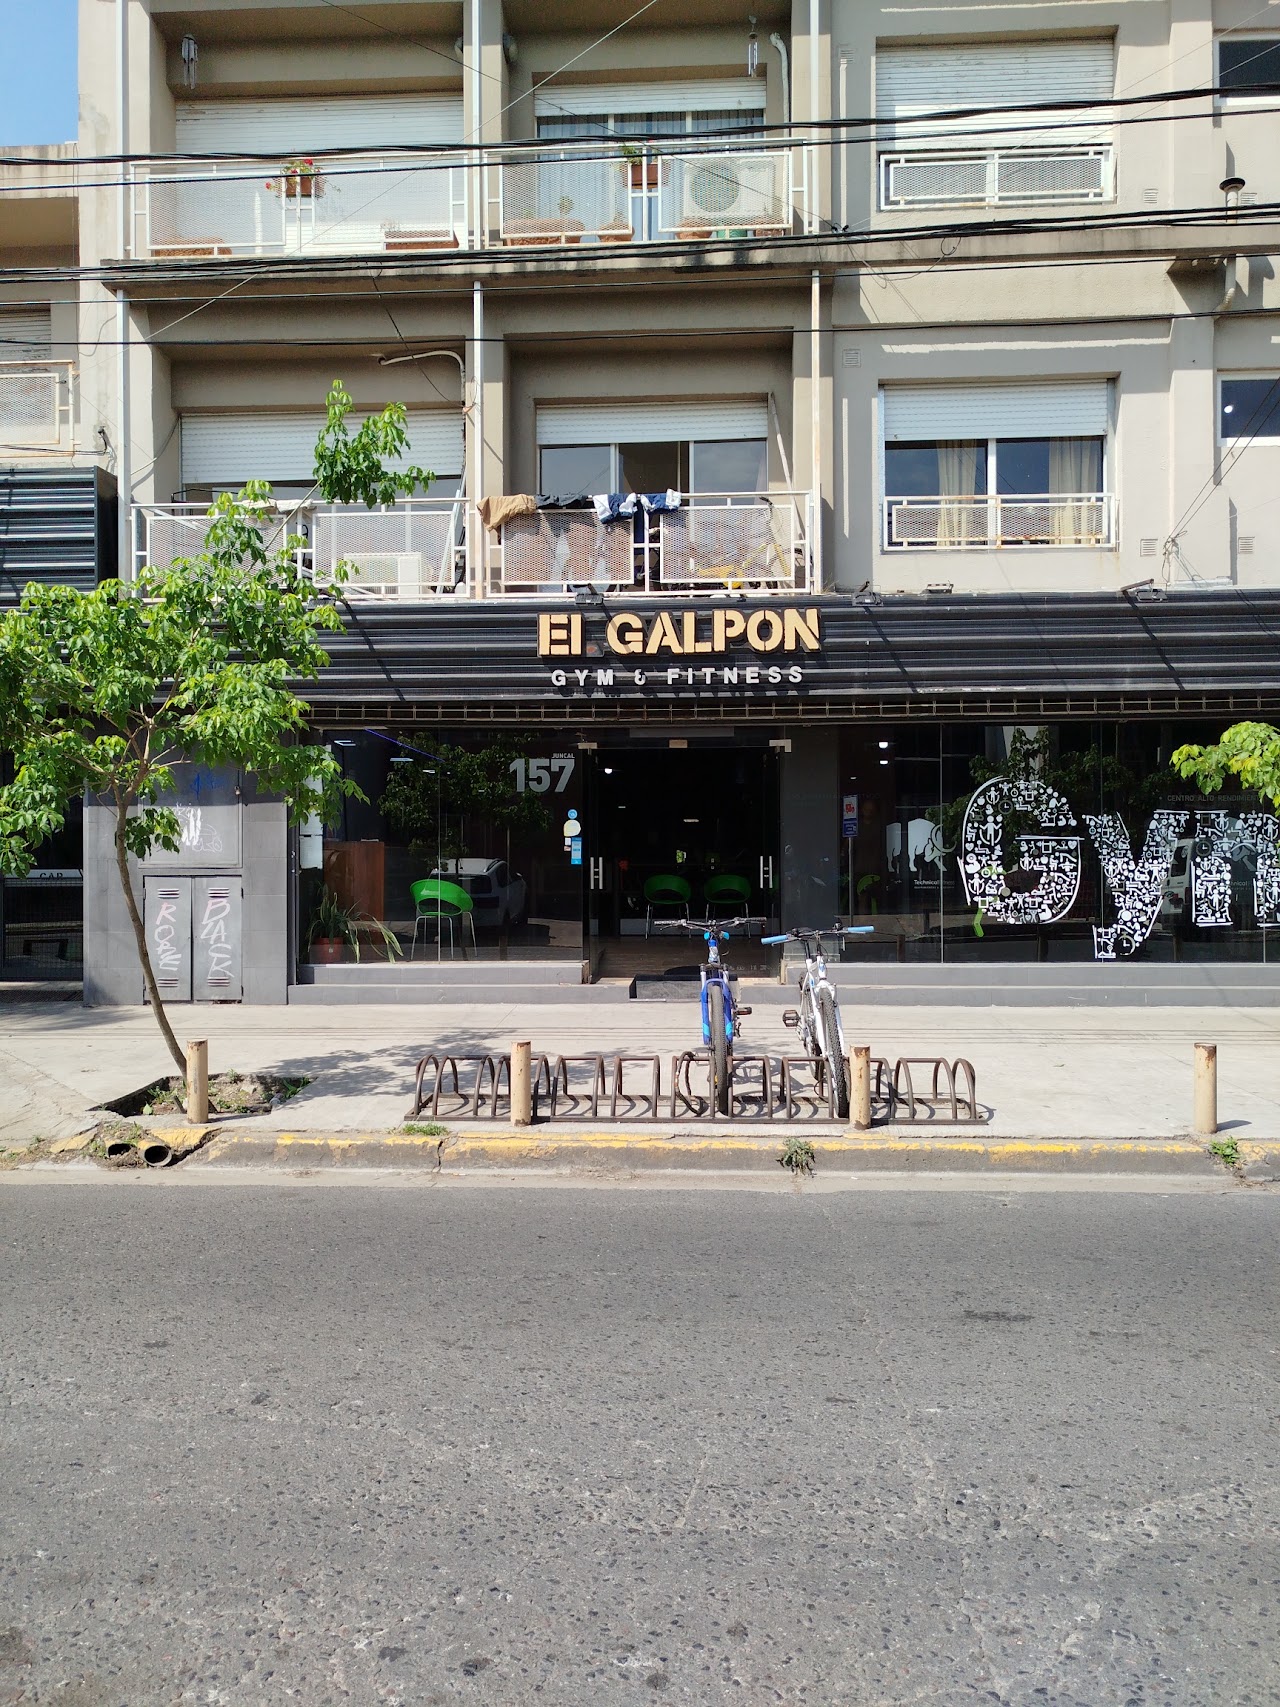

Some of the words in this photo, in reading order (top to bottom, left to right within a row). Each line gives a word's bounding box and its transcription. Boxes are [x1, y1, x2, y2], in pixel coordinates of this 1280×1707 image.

[606, 607, 820, 655] GALPON
[551, 668, 614, 687] GYM
[634, 667, 647, 686] &
[666, 664, 804, 685] FITNESS
[509, 758, 576, 793] 157
[1167, 794, 1195, 802] CENTRO
[1198, 794, 1214, 802] ALTO
